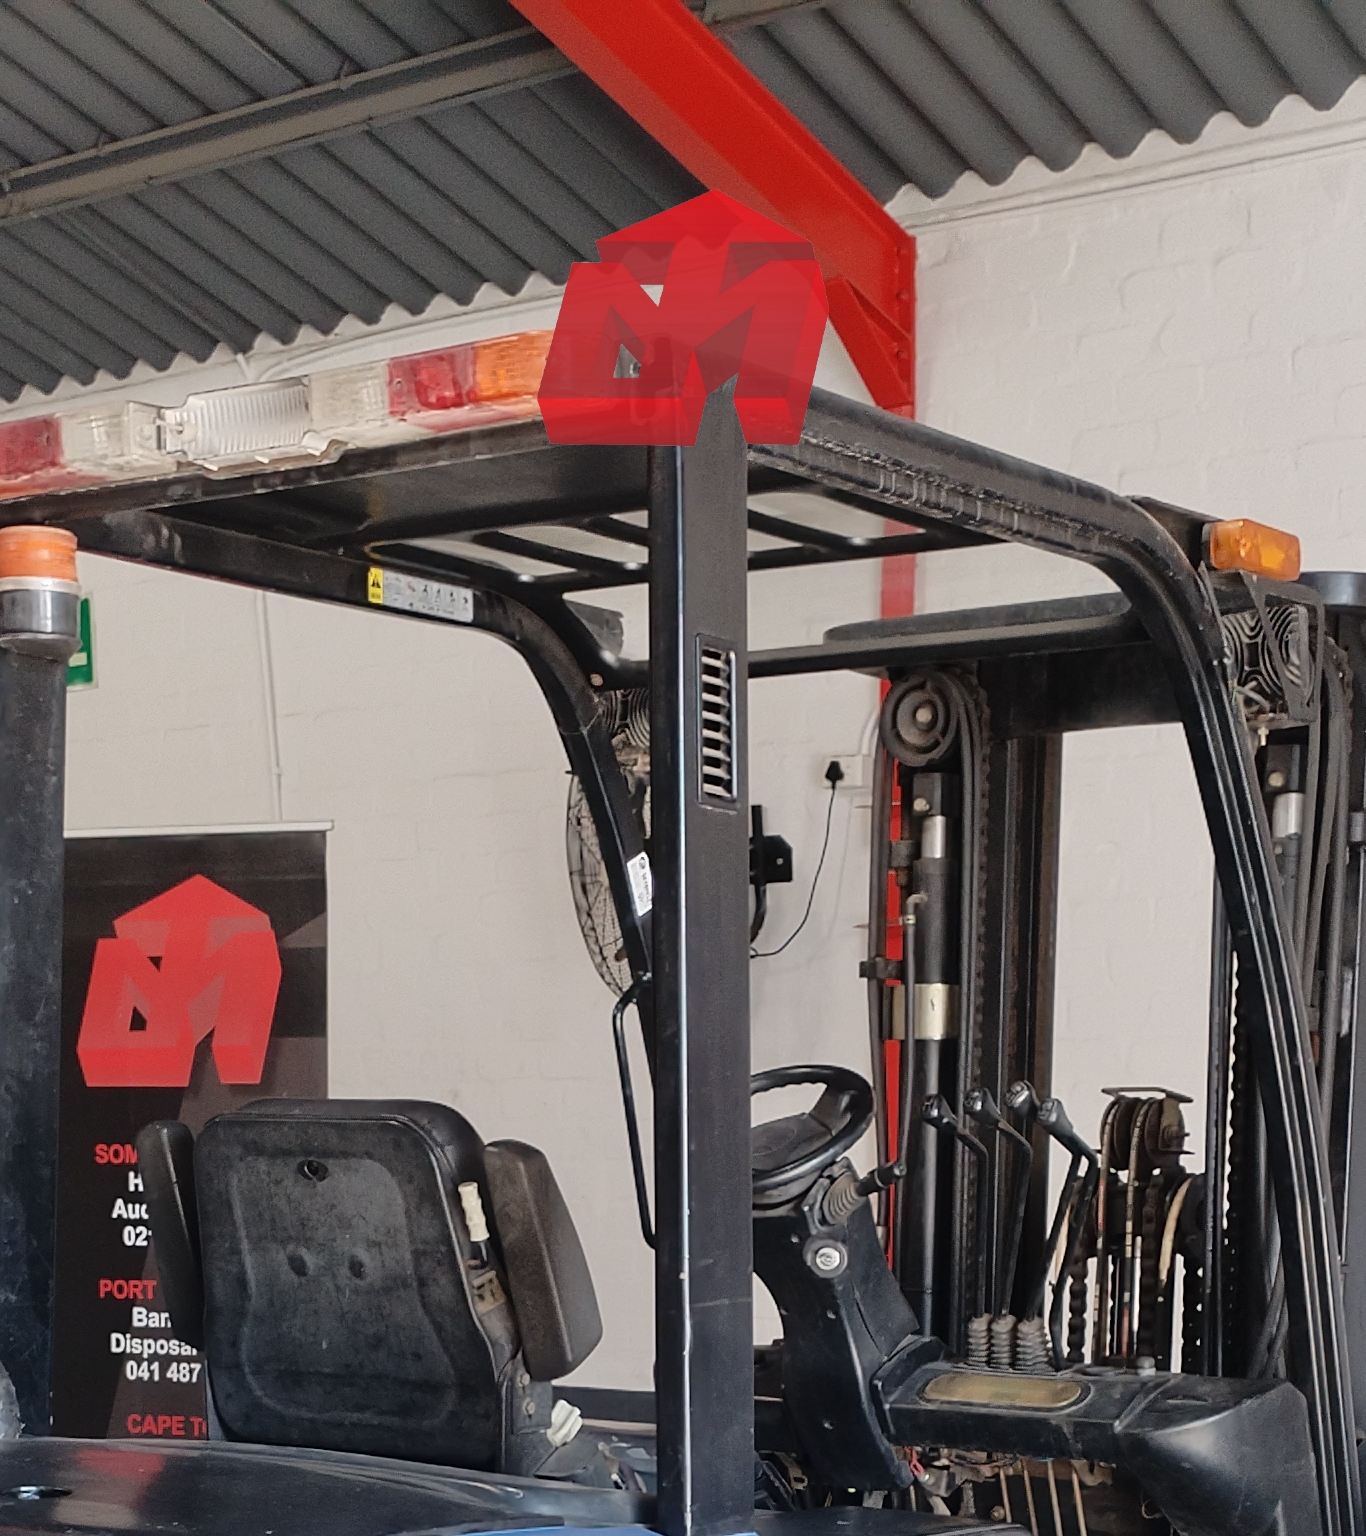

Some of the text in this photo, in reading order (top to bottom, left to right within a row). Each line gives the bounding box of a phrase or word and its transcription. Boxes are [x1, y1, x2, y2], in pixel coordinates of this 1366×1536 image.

[98, 1278, 157, 1300] PORT
[125, 1360, 202, 1383] 041 487
[126, 1413, 185, 1436] CAPE
